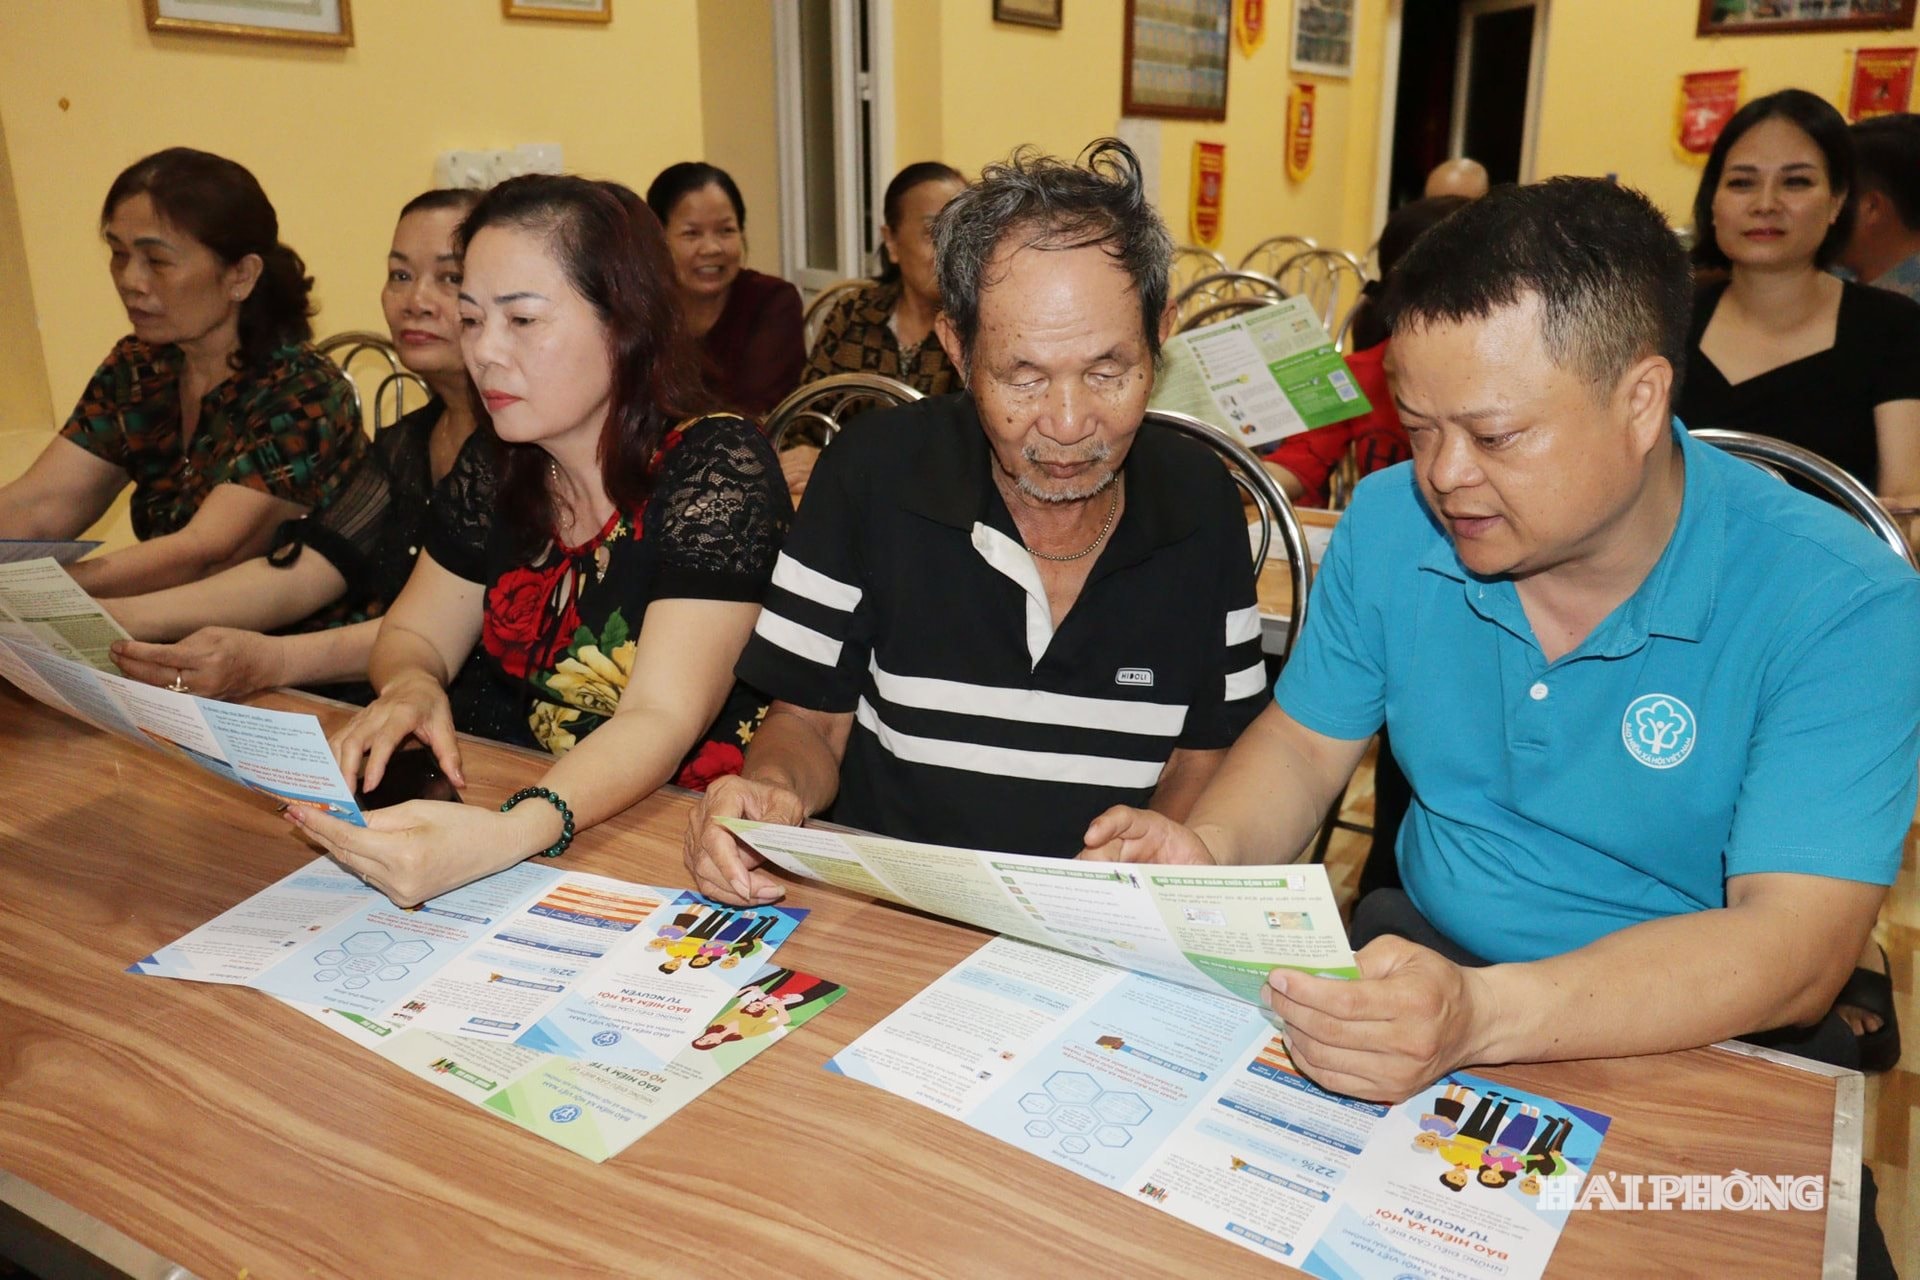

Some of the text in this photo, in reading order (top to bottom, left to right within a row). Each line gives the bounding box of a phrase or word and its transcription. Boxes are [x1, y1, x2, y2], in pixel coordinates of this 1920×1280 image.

[1121, 672, 1147, 681] HIDOLI
[1301, 1159, 1336, 1178] 22%
[1374, 1208, 1508, 1261] BẢO HIỂM XÃ HỘI
[1402, 1207, 1489, 1243] TỰ NGUYỆN
